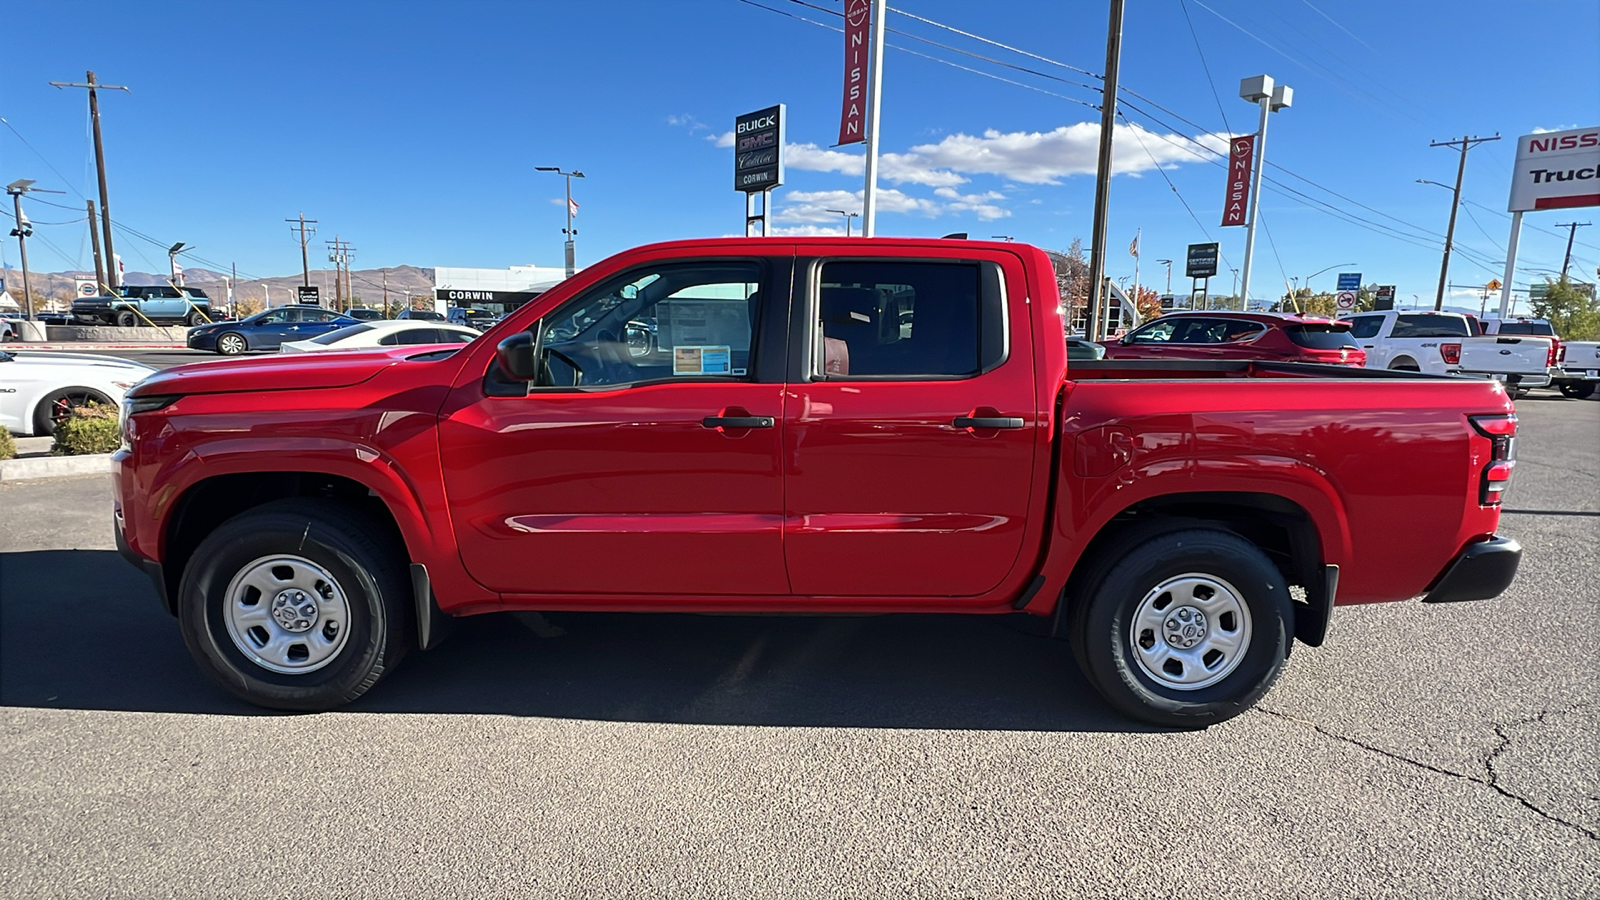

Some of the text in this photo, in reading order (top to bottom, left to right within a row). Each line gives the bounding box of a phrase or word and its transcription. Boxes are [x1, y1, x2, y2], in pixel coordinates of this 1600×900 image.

[846, 31, 862, 135] NISSAN
[738, 115, 775, 133] BUICK
[739, 132, 774, 150] GMC
[1529, 133, 1600, 153] NISS
[738, 151, 773, 169] Cadillac
[743, 172, 768, 185] CORWIN
[1229, 160, 1246, 221] NISSAN
[449, 291, 493, 300] CORWIN
